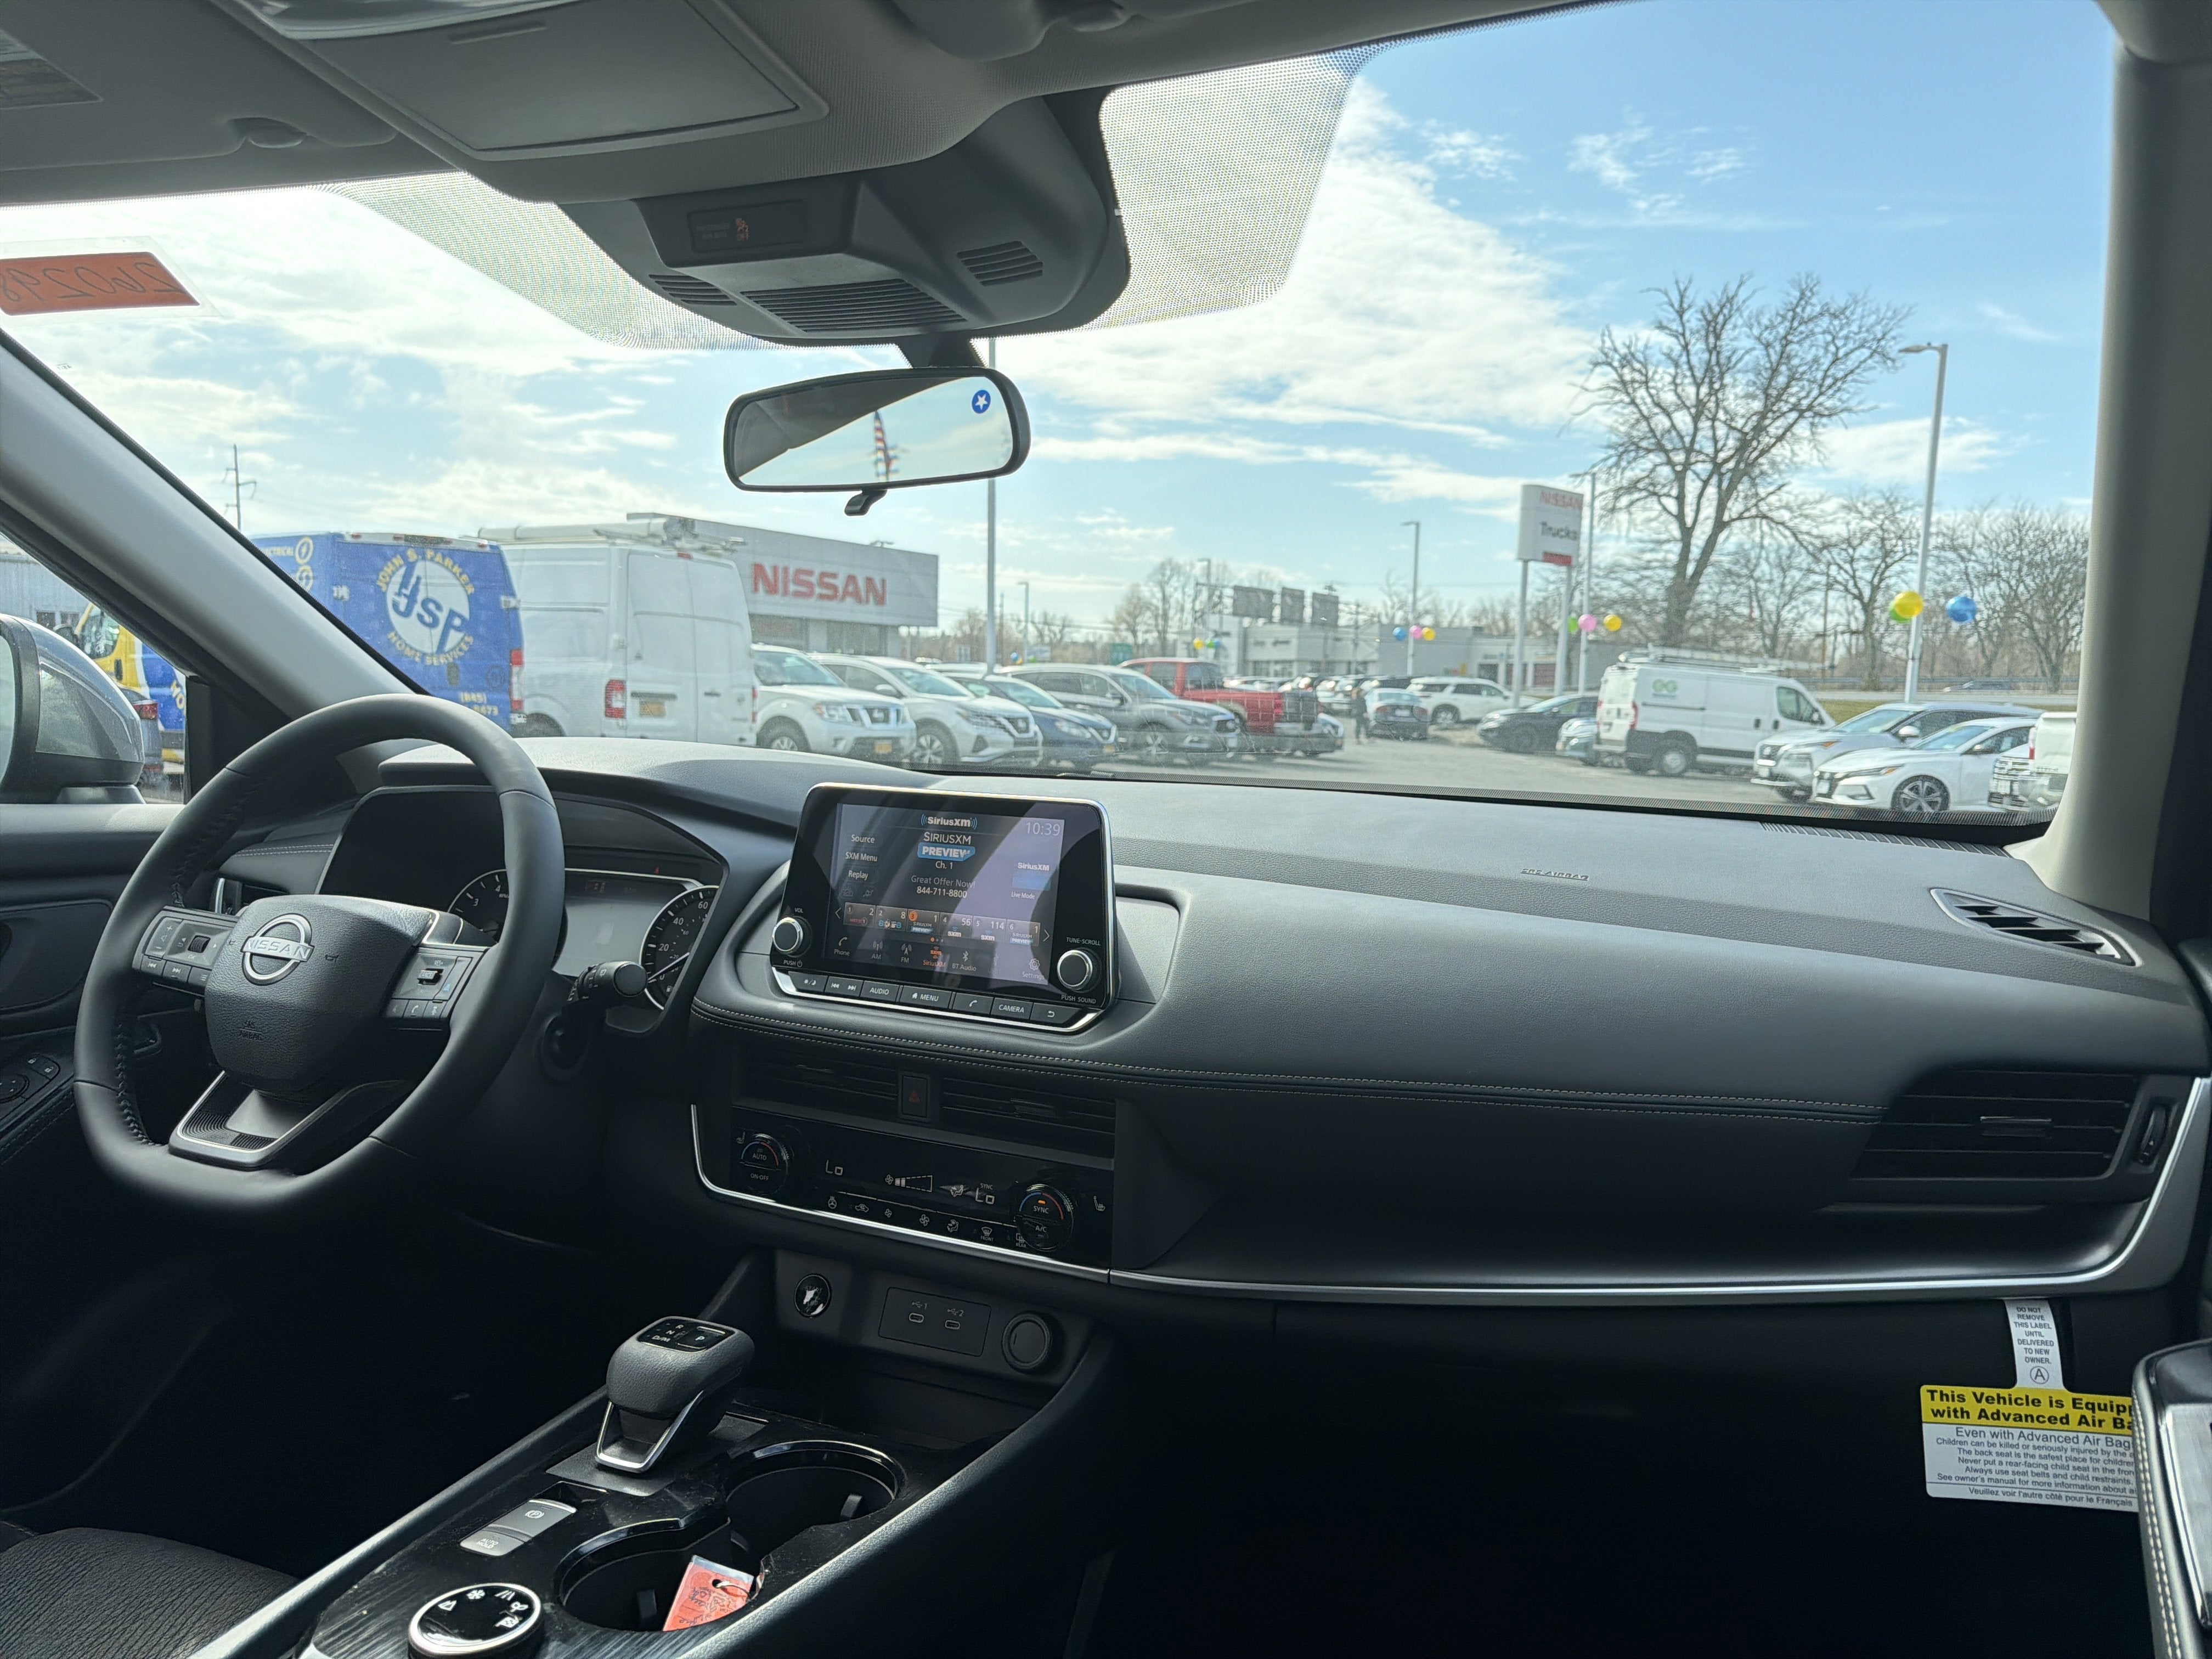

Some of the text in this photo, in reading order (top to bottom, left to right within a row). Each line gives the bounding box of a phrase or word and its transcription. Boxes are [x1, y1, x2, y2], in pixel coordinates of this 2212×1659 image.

[1541, 521, 1578, 540] Trucks
[376, 554, 404, 592] JOHN
[426, 549, 475, 595] PARKER
[752, 562, 887, 607] NISSAN
[388, 631, 474, 666] HOME SERVICES
[1026, 822, 1061, 836] 10:39
[851, 834, 876, 844] Source
[923, 832, 972, 845] SIRIUSXM
[845, 851, 878, 862] SXM Menu
[935, 861, 947, 870] Ch.
[1017, 862, 1050, 871] SiriusXM
[848, 870, 868, 881] Replay
[1544, 870, 1589, 882] AIRBAG
[911, 875, 976, 889] Great Offer Now!
[917, 886, 968, 899] 844-711-8800
[472, 898, 479, 906] 3
[698, 901, 708, 910] 60
[869, 908, 874, 916] 2
[900, 911, 906, 919] 8
[673, 917, 684, 926] 40
[961, 918, 971, 926] 56
[991, 921, 1005, 930] 114
[249, 939, 312, 960] NISSAN
[658, 943, 669, 952] 20
[923, 960, 946, 968] SiriusXM
[1022, 971, 1045, 980] Settings
[869, 987, 890, 996] AUDIO
[919, 994, 939, 1002] MENU
[998, 1004, 1025, 1013] CAMERA
[752, 1153, 768, 1161] AUTO
[825, 1159, 844, 1176] Lo
[975, 1187, 995, 1205] Lo
[1033, 1205, 1049, 1214] SYNC
[2017, 1339, 2055, 1347] DELIVERED
[2034, 1368, 2046, 1381] A
[1926, 1389, 2065, 1409] This Vehicle is
[1931, 1406, 2106, 1427] with Advanced Air
[1956, 1426, 1986, 1438] Even
[1990, 1430, 2014, 1440] with
[2017, 1431, 2079, 1444] Advanced
[2083, 1435, 2101, 1446] Air
[1936, 1437, 1968, 1446] Children
[1999, 1441, 2019, 1449] killed
[2032, 1444, 2068, 1453] seriously
[2070, 1446, 2099, 1455] injured
[2101, 1448, 2111, 1457] by
[1974, 1448, 1993, 1457] back
[2065, 1455, 2087, 1464] place
[1958, 1456, 1982, 1464] Never
[2005, 1460, 2049, 1470] rear-facing
[2051, 1463, 2070, 1471] child
[2102, 1466, 2116, 1475] the
[1965, 1466, 1993, 1476] Always
[2070, 1472, 2089, 1481] child
[2091, 1475, 2134, 1485] restraints.
[1954, 1475, 1985, 1483] owner's
[2018, 1477, 2029, 1486] for
[2055, 1481, 2101, 1491] information
[2102, 1485, 2127, 1493] about
[1968, 1487, 2000, 1496] Veuillez
[2096, 1497, 2133, 1507] Français
